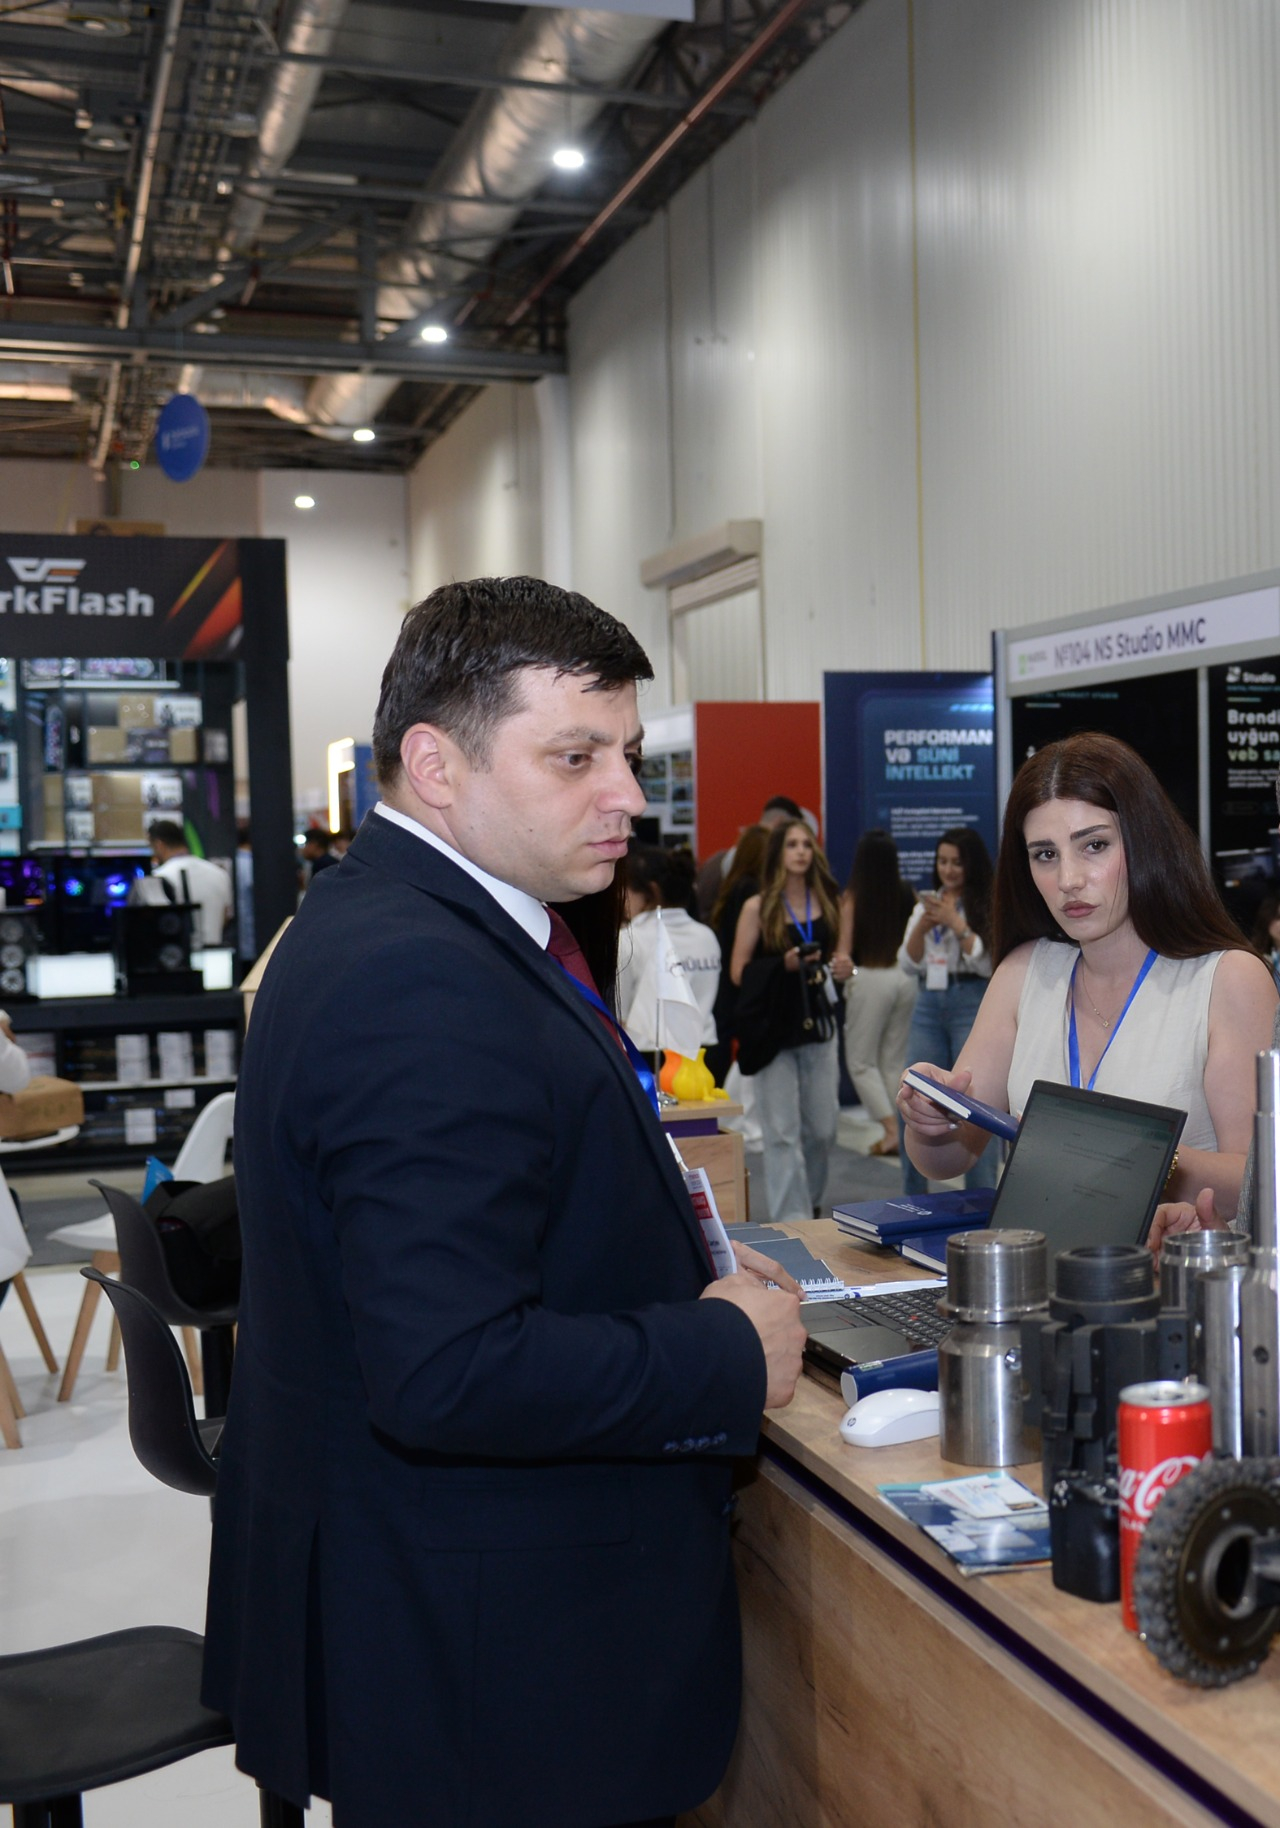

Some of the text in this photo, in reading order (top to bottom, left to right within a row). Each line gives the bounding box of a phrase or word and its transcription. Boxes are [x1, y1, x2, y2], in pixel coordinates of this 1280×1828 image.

[1094, 635, 1113, 661] NS
[1116, 625, 1162, 658] Studio
[1167, 618, 1206, 649] MMC
[1227, 746, 1259, 762] veb
